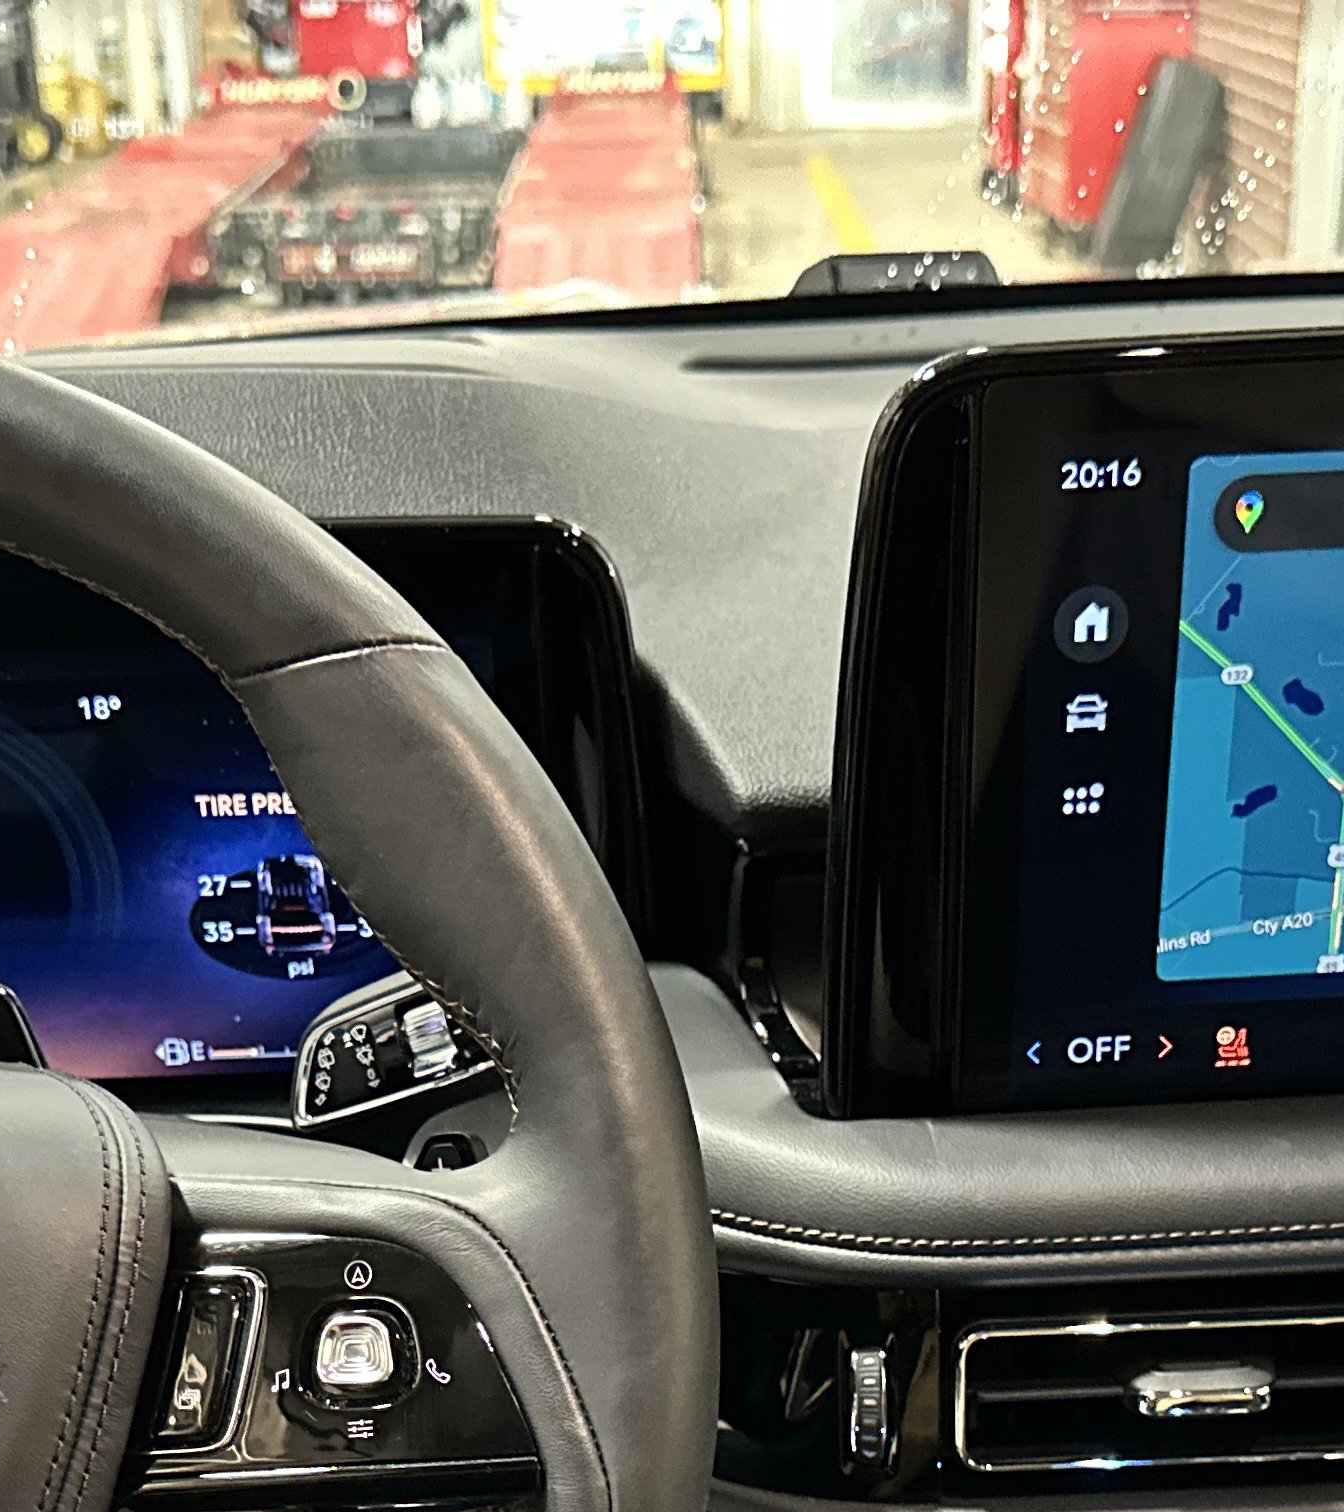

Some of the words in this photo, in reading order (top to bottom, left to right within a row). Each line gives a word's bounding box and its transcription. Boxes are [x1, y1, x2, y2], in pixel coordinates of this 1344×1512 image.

[1060, 460, 1143, 492] 20:16
[1225, 668, 1249, 682] 132
[194, 793, 248, 818] TIRE
[197, 875, 228, 897] 27
[201, 920, 234, 944] 35
[1252, 919, 1279, 936] Cty
[1281, 911, 1314, 931] A20
[1156, 936, 1188, 954] lins
[1189, 929, 1211, 946] Rd
[287, 955, 315, 979] psi
[191, 1041, 206, 1060] E
[1067, 1034, 1132, 1064] OFF
